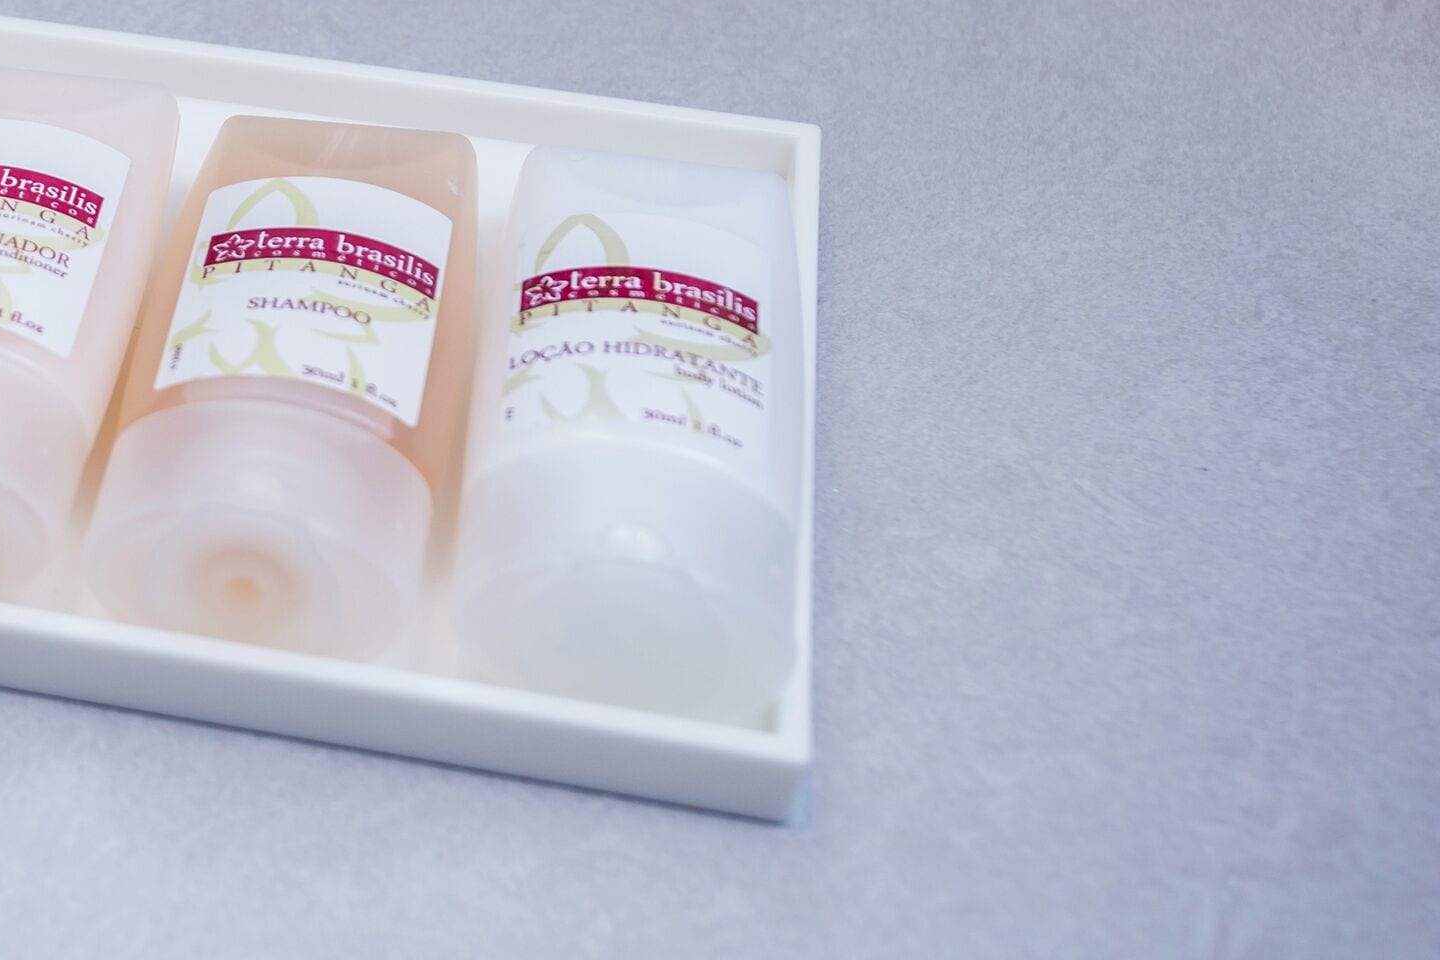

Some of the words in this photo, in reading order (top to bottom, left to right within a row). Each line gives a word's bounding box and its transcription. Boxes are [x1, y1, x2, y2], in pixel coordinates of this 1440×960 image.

[0, 168, 98, 216] brasilis
[257, 231, 325, 250] terra
[337, 234, 433, 286] brasilis
[202, 259, 430, 313] PITANGA
[247, 297, 371, 324] SHAMPOO
[570, 271, 642, 290] terra
[653, 271, 757, 321] brasilis
[519, 299, 758, 349] PITANGA
[603, 341, 764, 396] HIDRATANTE
